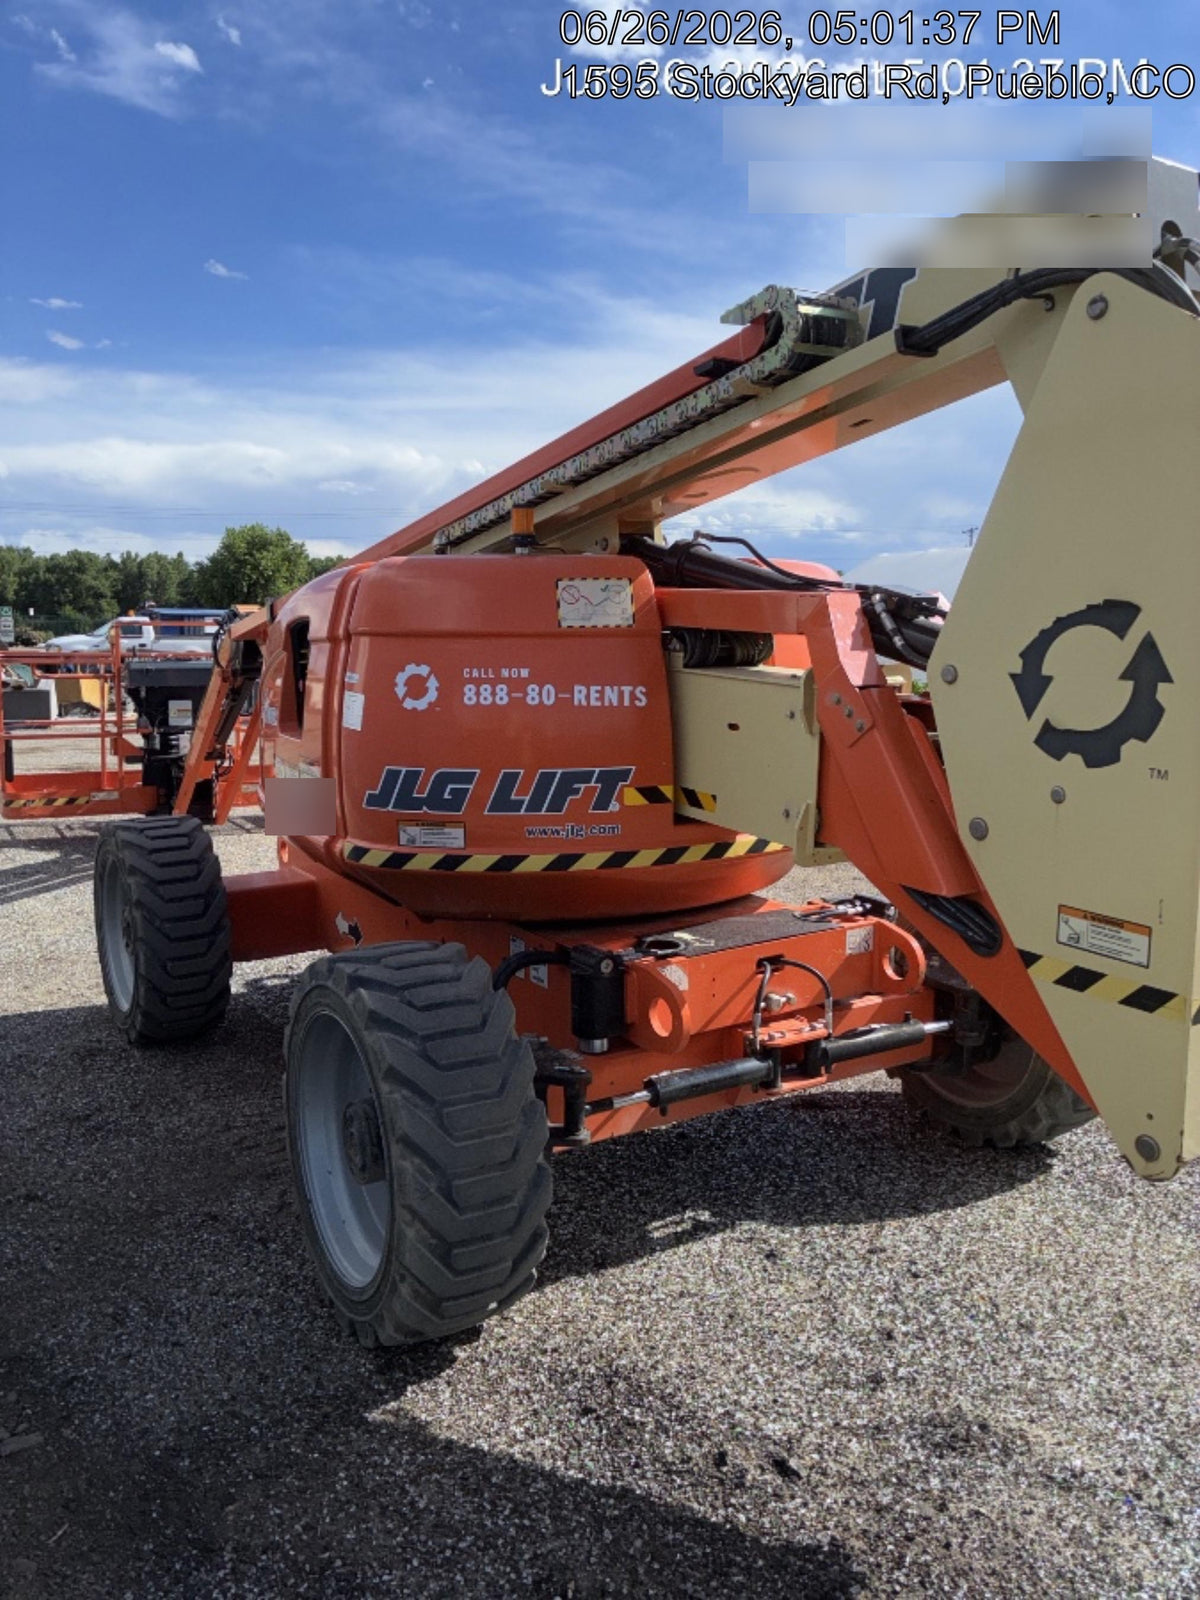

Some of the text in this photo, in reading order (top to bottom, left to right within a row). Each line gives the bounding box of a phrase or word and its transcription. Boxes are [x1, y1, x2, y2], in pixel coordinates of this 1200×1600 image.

[463, 668, 530, 678] CALL NOW
[463, 684, 648, 707] 888-80-RENTS
[362, 766, 636, 814] JLG LIFT
[525, 824, 621, 839] www.jlg.com
